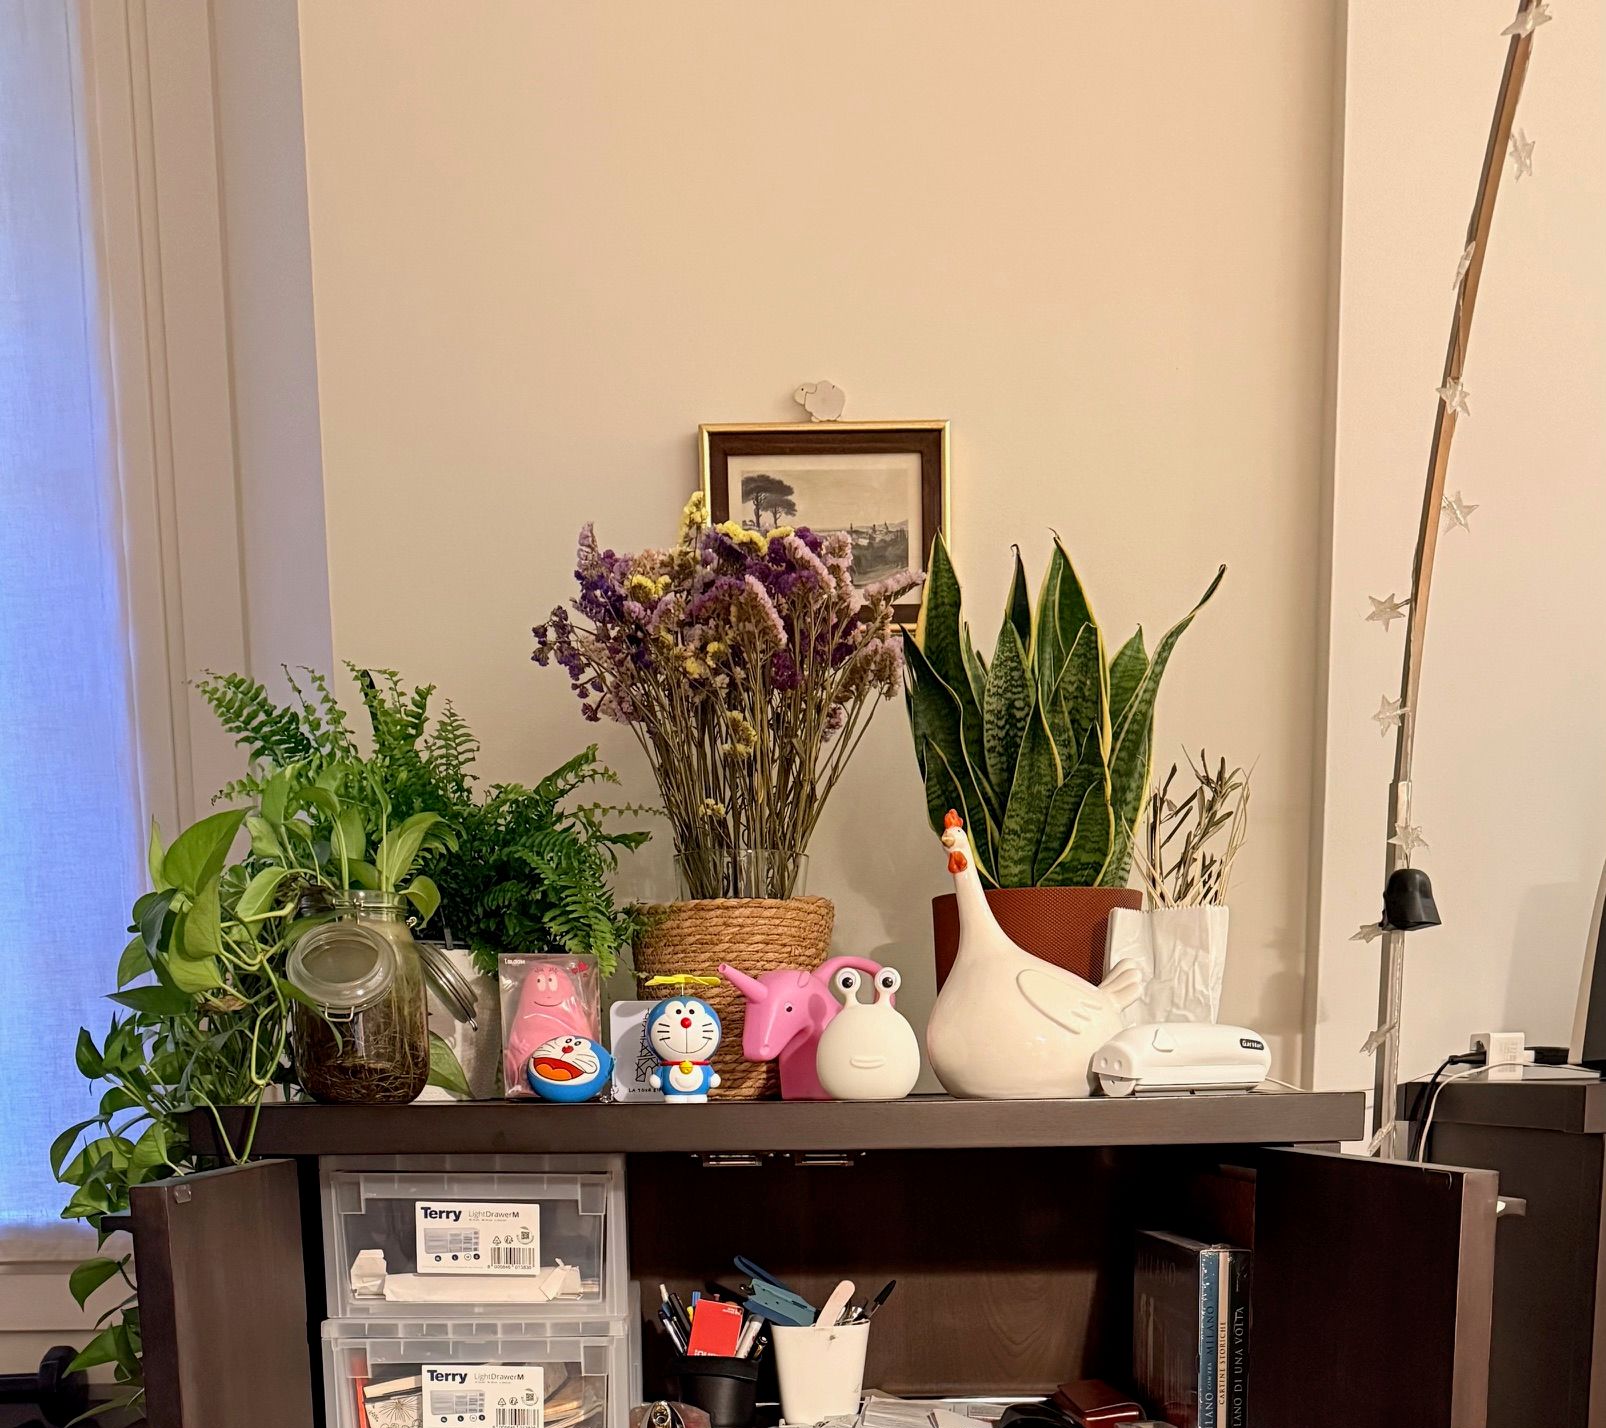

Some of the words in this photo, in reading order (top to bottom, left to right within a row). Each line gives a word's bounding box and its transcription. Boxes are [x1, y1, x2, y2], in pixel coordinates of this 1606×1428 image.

[421, 1207, 462, 1222] Terry
[1206, 1305, 1215, 1355] MILANO
[1234, 1306, 1245, 1343] VOLTA
[1234, 1349, 1243, 1374] UNA
[426, 1369, 468, 1384] Terry
[1234, 1378, 1243, 1391] DI
